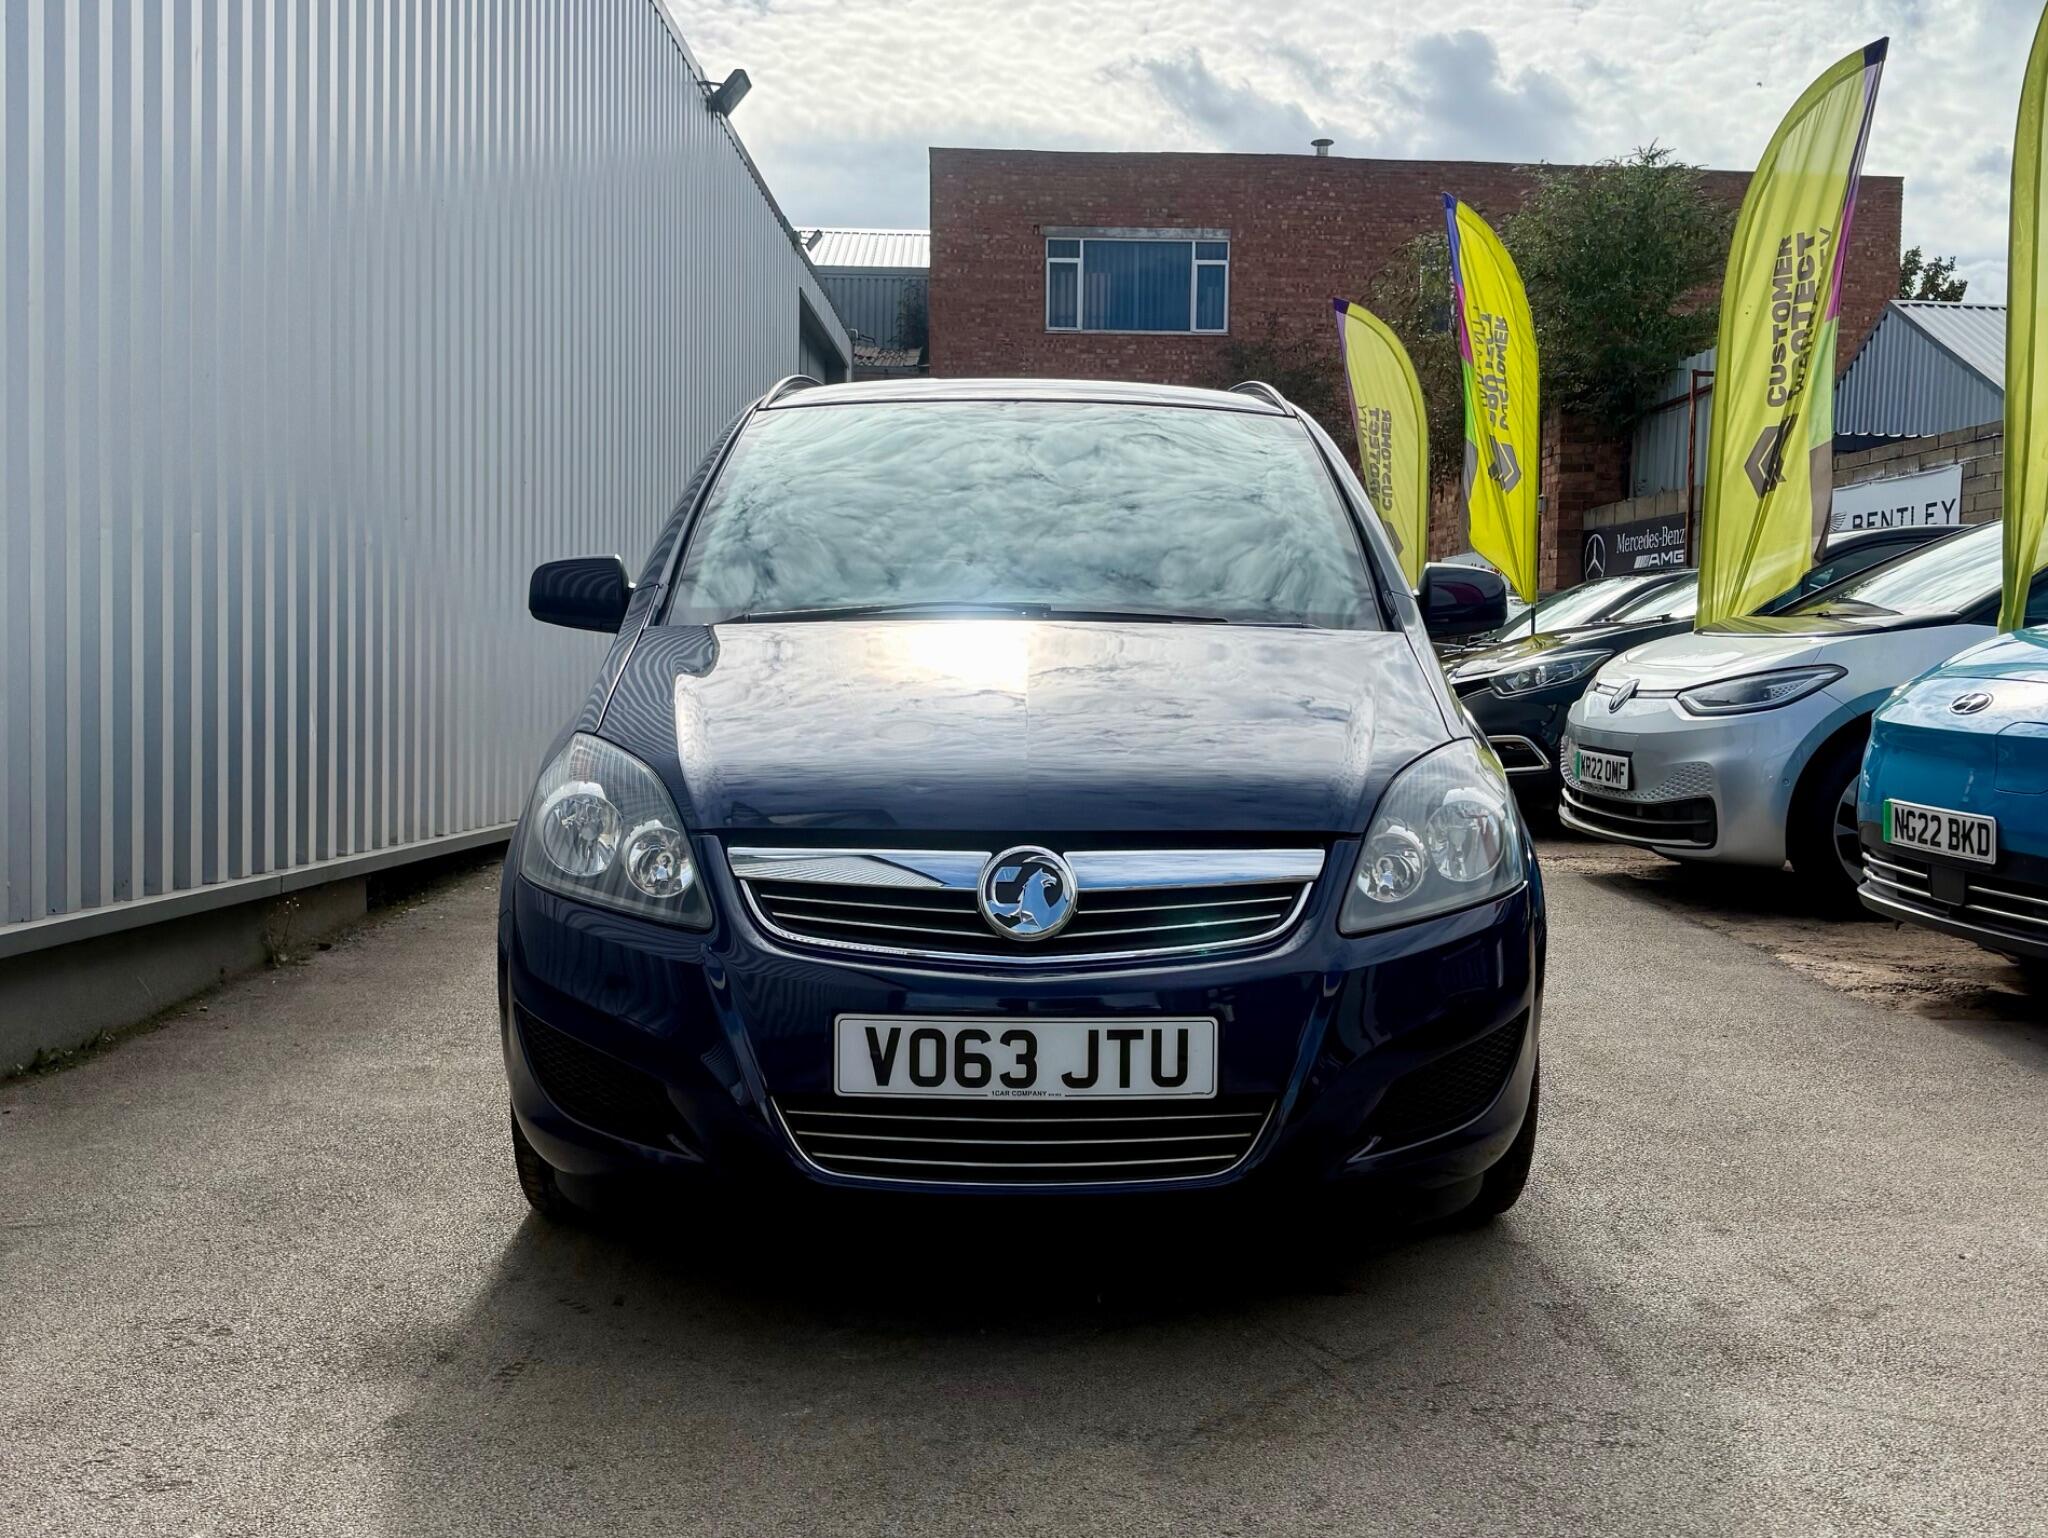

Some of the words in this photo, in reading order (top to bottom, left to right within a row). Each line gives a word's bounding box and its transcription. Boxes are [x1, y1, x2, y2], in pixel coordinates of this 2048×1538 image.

[1767, 234, 1793, 407] CUSTOMER
[1788, 232, 1816, 397] OTECT
[1615, 526, 1686, 554] Mercedes-Benz
[1648, 549, 1685, 567] AMG
[1894, 807, 1942, 848] NG22
[1948, 818, 1990, 857] BKD
[864, 1026, 1038, 1089] VO63
[1060, 1028, 1189, 1089] JTU
